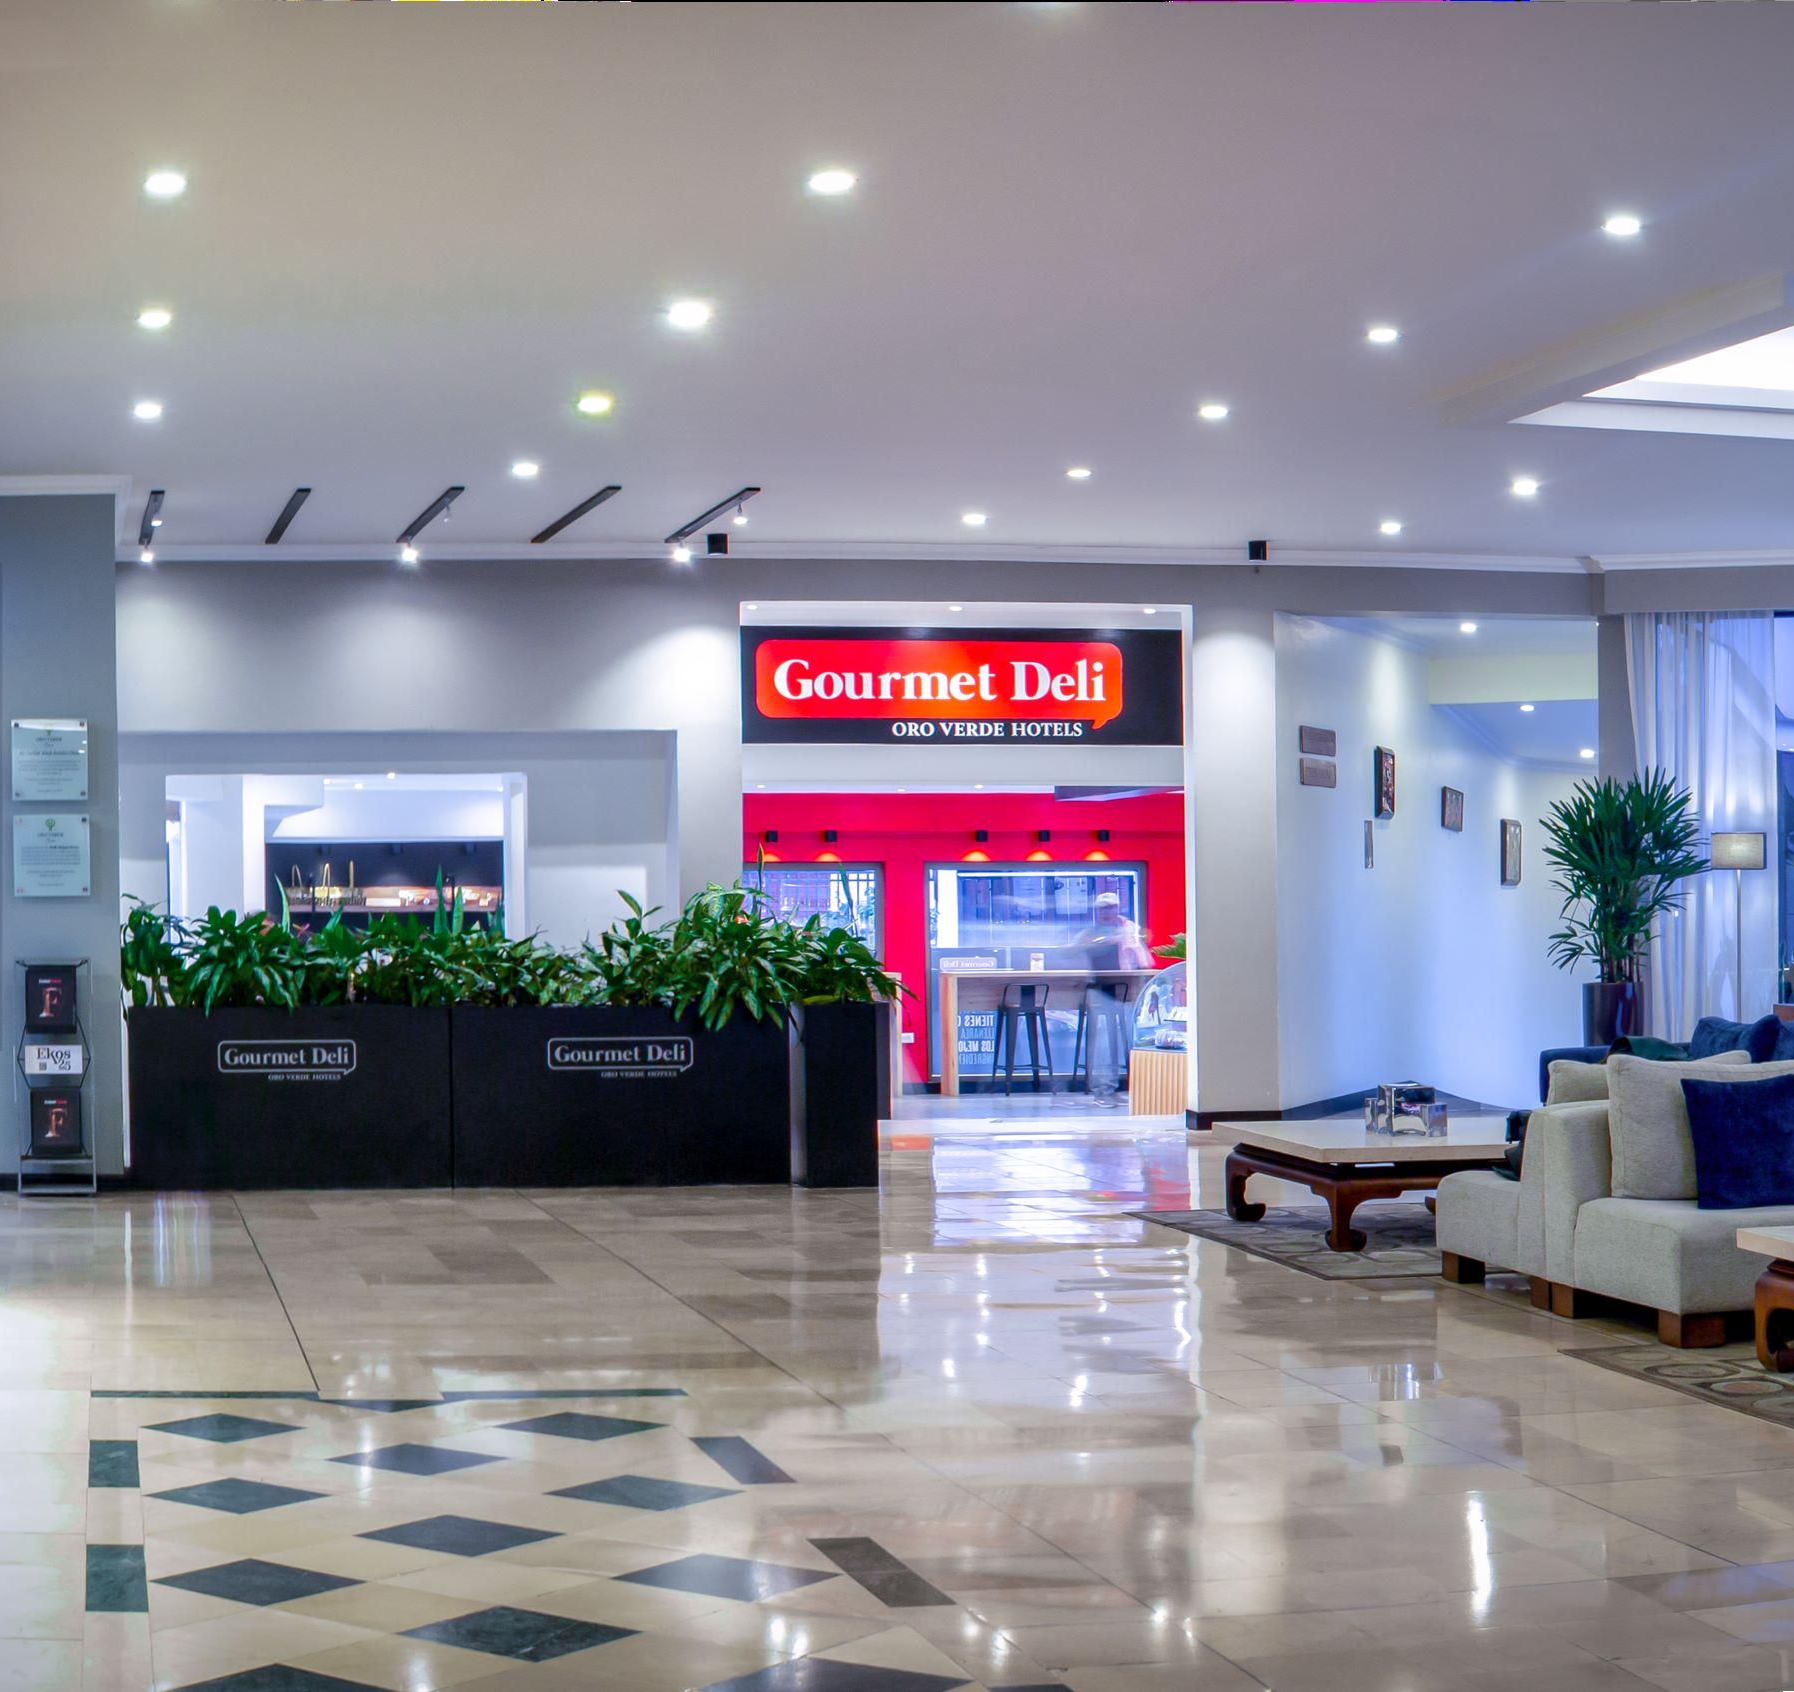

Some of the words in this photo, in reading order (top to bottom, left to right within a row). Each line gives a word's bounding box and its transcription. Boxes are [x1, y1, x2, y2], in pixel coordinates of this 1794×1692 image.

[773, 658, 998, 701] Gourmet
[1010, 660, 1107, 702] Deli
[891, 721, 935, 738] ORO
[939, 721, 1005, 738] VERDE
[1010, 721, 1083, 738] HOTELS
[37, 1047, 72, 1065] Ekos
[224, 1047, 307, 1066] Gourmet
[311, 1046, 349, 1065] Deli
[554, 1044, 641, 1063] Gourmet
[647, 1043, 686, 1062] Deli
